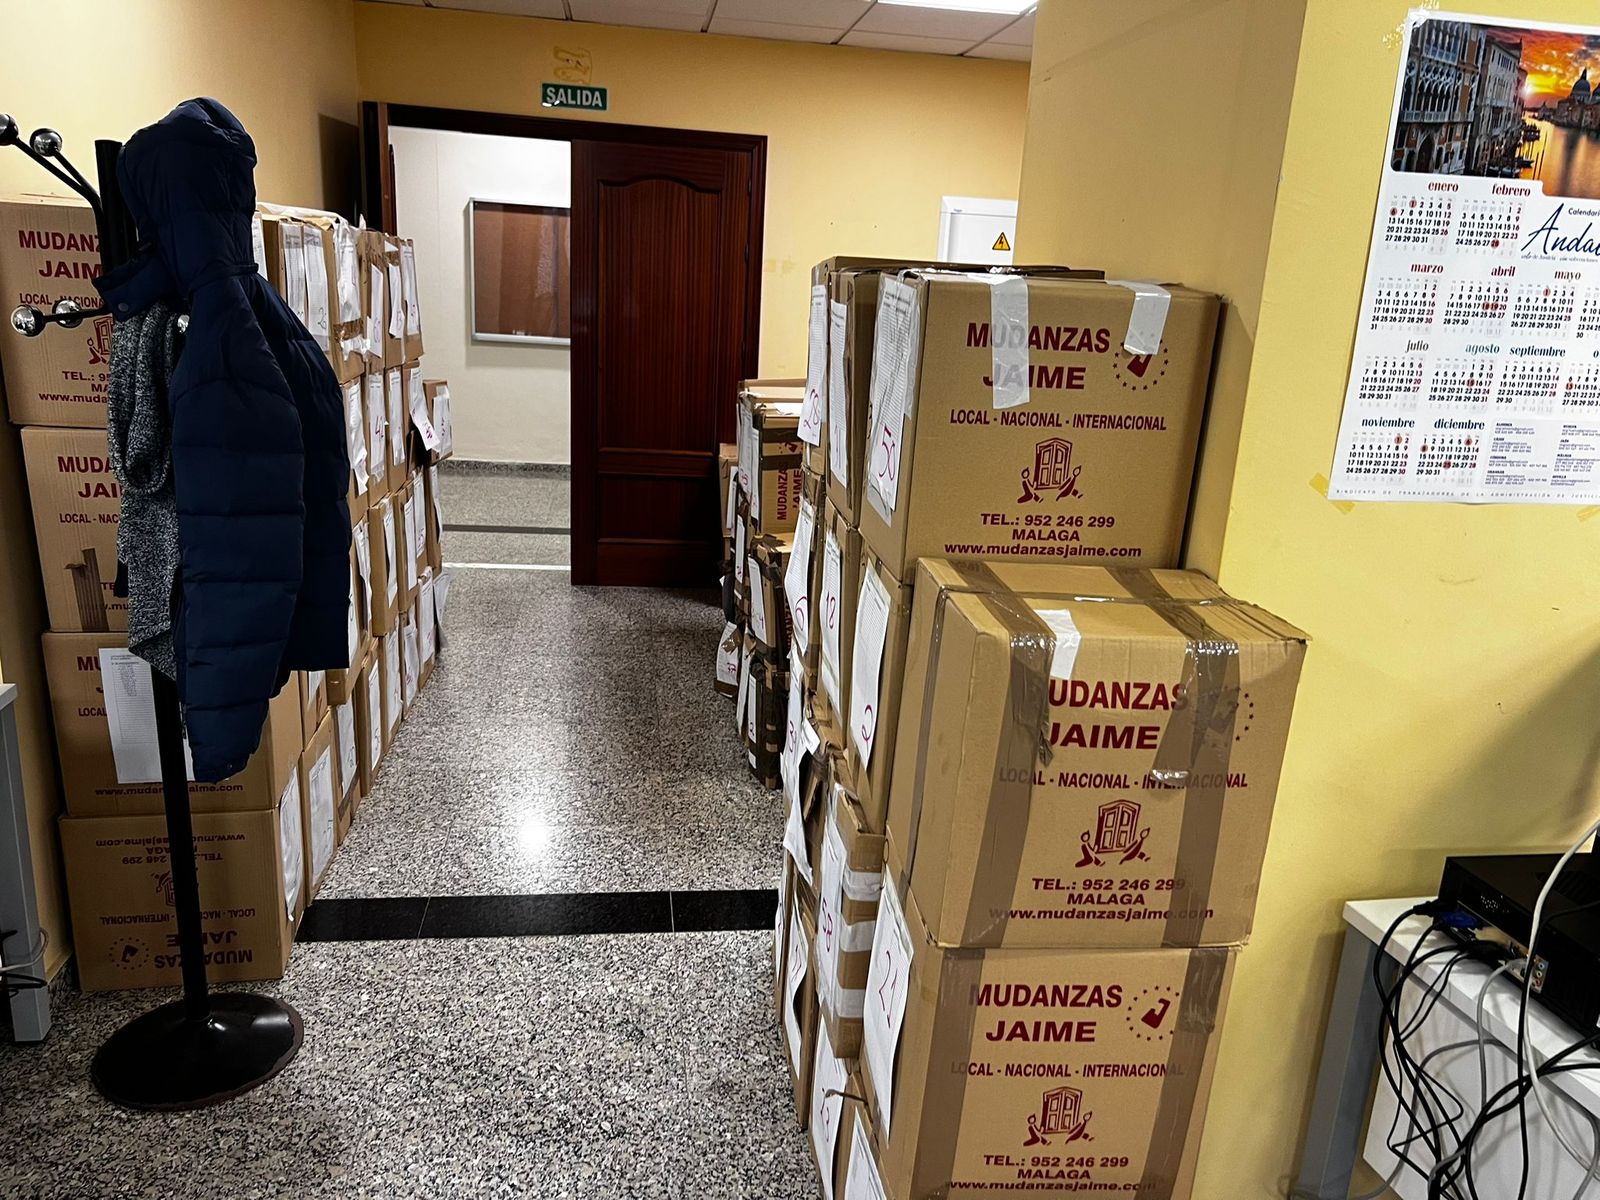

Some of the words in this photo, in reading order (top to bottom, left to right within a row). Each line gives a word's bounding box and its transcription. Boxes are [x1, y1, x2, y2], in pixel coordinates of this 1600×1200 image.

[546, 87, 603, 107] SALIDA
[1428, 182, 1459, 192] enero
[1492, 184, 1531, 197] febrero
[1410, 264, 1444, 274] marzo
[1491, 266, 1516, 277] abril
[1554, 271, 1582, 283] mayo
[20, 293, 52, 306] LOCAL
[966, 322, 1110, 353] MUDANZAS
[1405, 340, 1429, 353] julio
[1464, 342, 1500, 354] agosto
[1510, 345, 1566, 358] septiembre
[62, 370, 95, 381] TEL.:
[983, 364, 1086, 390] JAIME
[950, 410, 990, 425] LOCAL
[1000, 412, 1062, 428] NACIONAL
[1072, 414, 1167, 430] INTERNACIONAL
[1362, 416, 1416, 428] noviembre
[1434, 418, 1485, 430] diciembre
[78, 482, 123, 498] JAI
[60, 513, 92, 524] LOCAL
[980, 514, 1020, 527] TEL.:
[1024, 514, 1051, 527] 952
[1055, 514, 1083, 528] 246
[1088, 516, 1116, 528] 299
[1012, 529, 1080, 542] MALAGA
[944, 542, 1142, 558] www.mudanzasjaime.com
[1048, 678, 1189, 711] UDANZAS
[1050, 722, 1160, 750] JAIME
[1058, 772, 1130, 790] NACIONAL
[122, 856, 142, 864] 299
[1032, 878, 1076, 890] TEL.:
[1082, 878, 1114, 891] 952
[1118, 878, 1150, 891] 246
[1154, 879, 1186, 891] 299
[1066, 893, 1146, 906] MALAGA
[100, 913, 170, 925] INTERNACIONAL
[229, 908, 256, 918] LOCAL
[970, 984, 1122, 1008] MUDANZAS
[986, 1020, 1097, 1042] JAIME
[951, 1060, 994, 1076] LOCAL
[1004, 1063, 1072, 1078] NACIONAL
[1082, 1063, 1184, 1078] INTERNACIONAL
[984, 1154, 1026, 1167] TEL.:
[1030, 1156, 1060, 1168] 952
[1065, 1156, 1095, 1168] 246
[1100, 1157, 1130, 1168] 299
[1017, 1168, 1091, 1180] MALAGA
